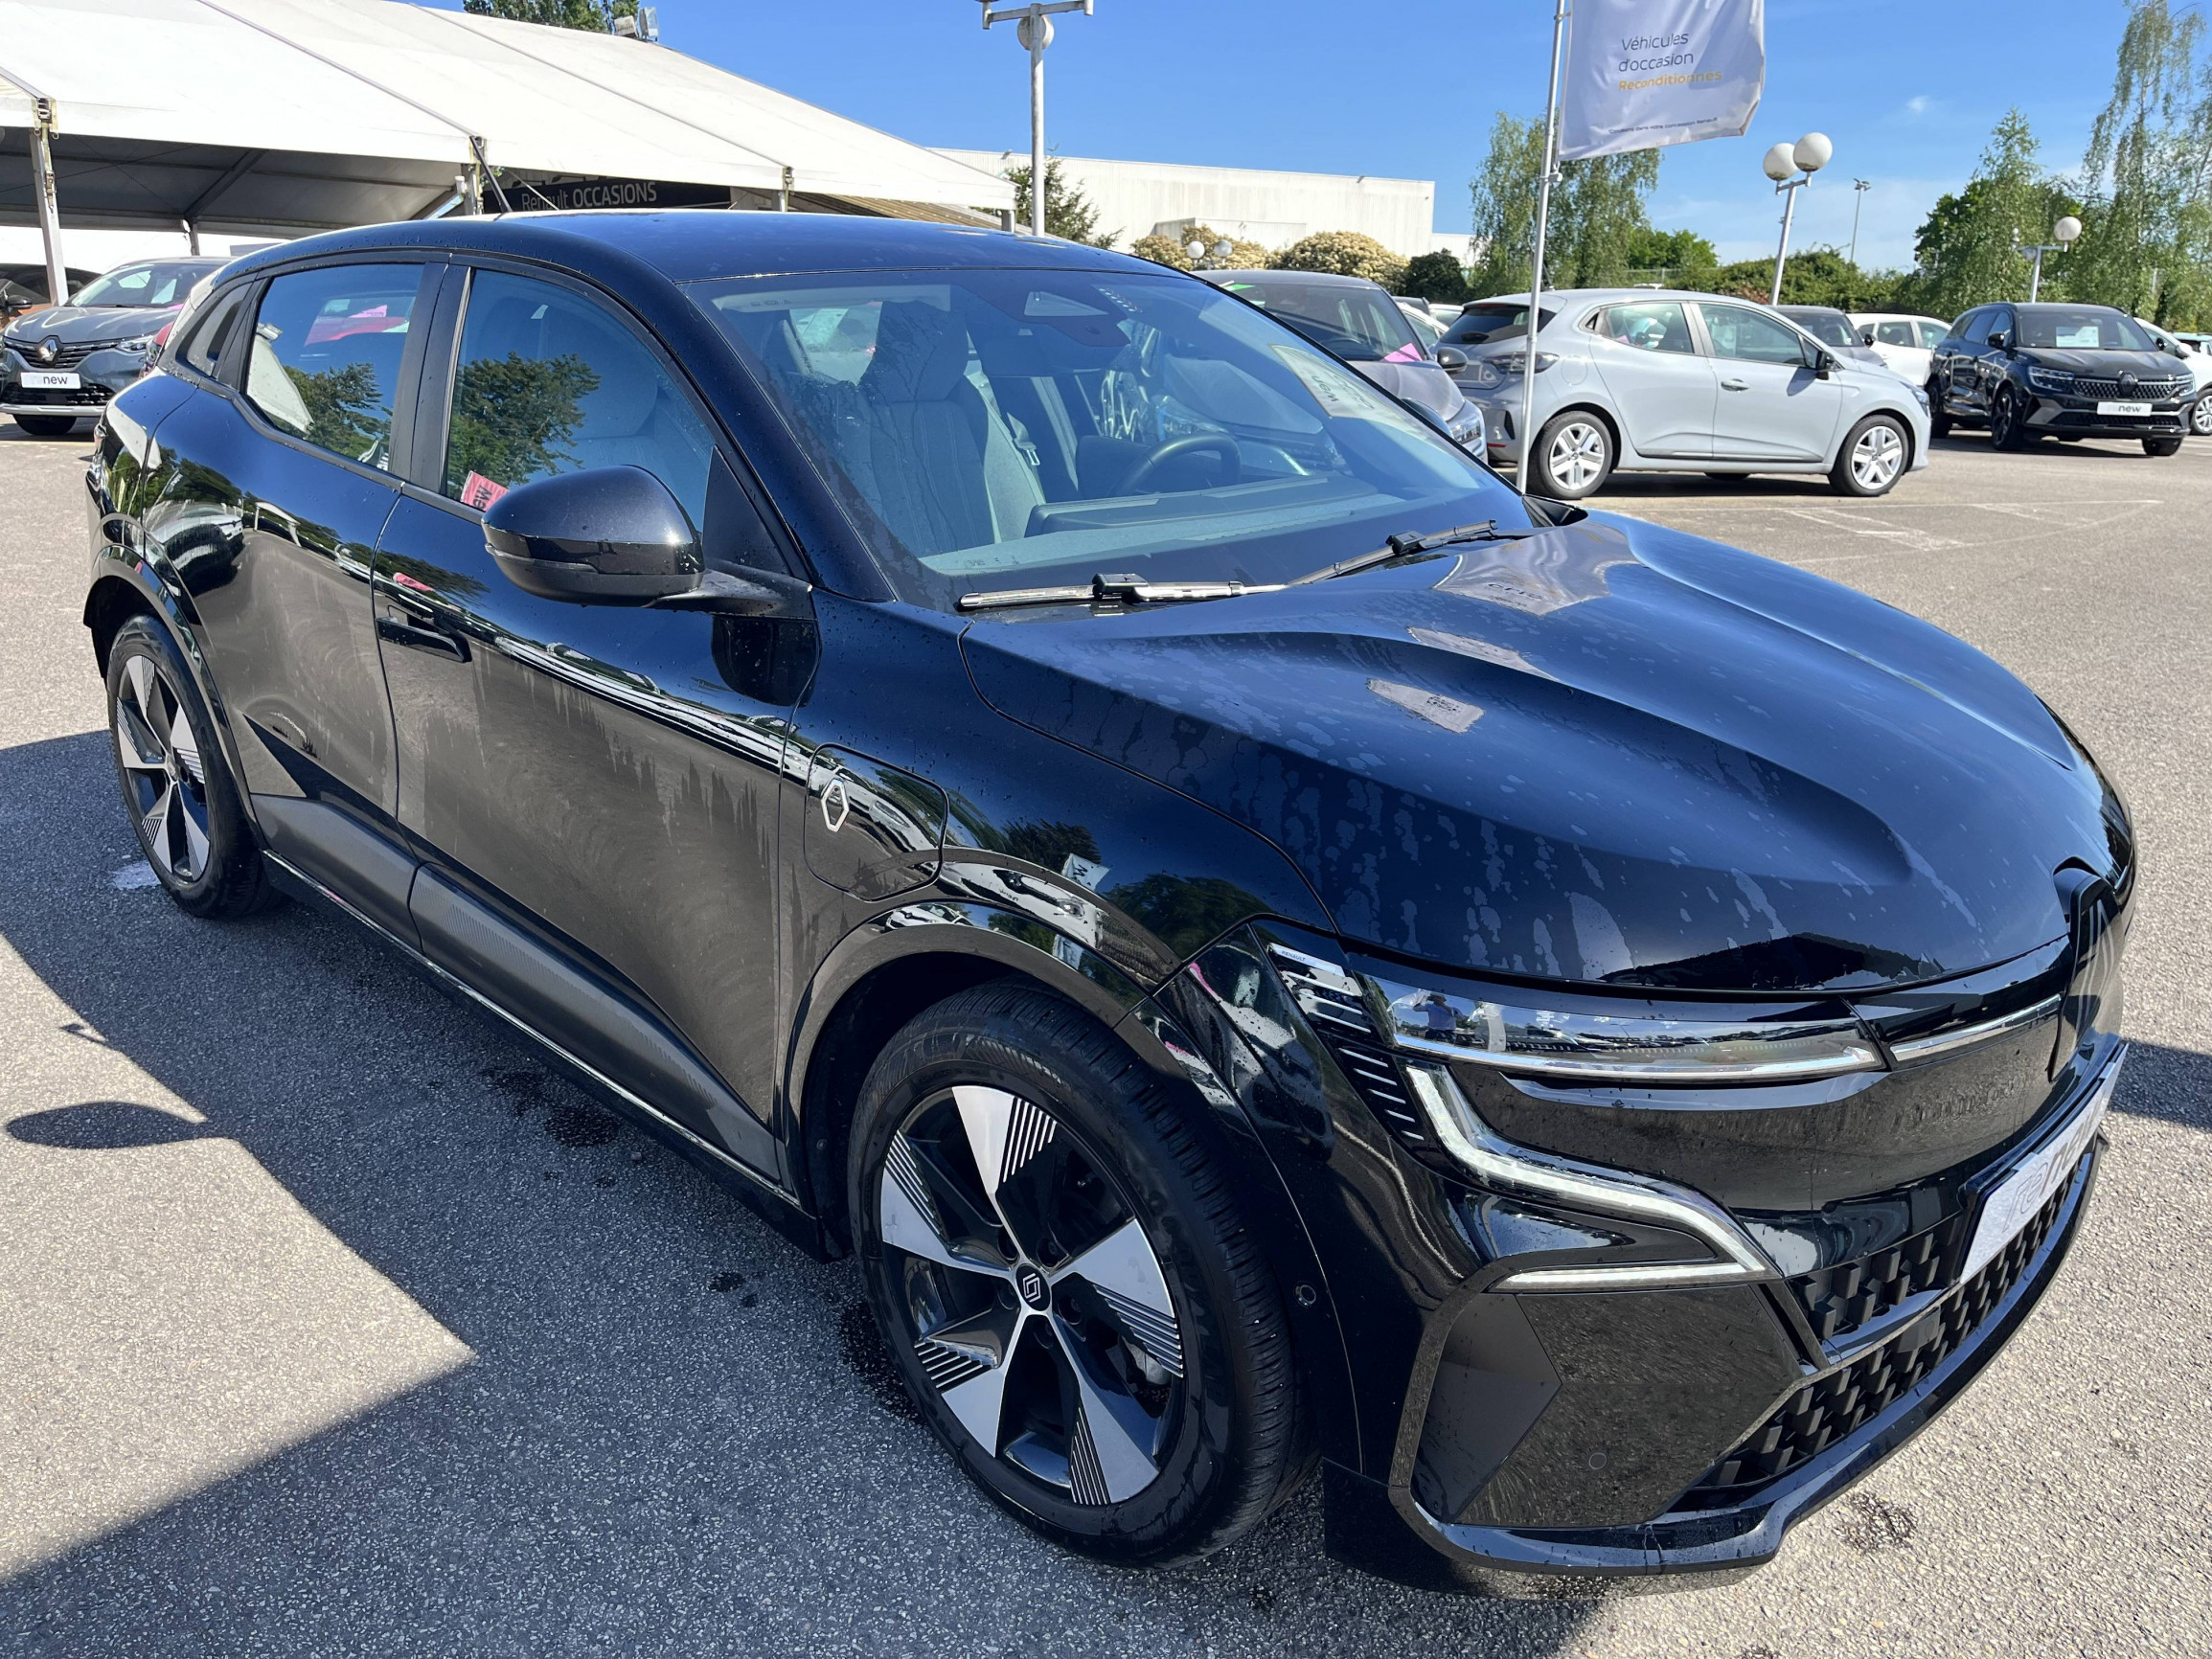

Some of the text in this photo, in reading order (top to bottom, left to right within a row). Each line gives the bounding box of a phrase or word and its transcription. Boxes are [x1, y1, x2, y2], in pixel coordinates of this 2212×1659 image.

[1621, 34, 1689, 51] Véhicules
[1618, 53, 1694, 72] d'occasion
[1618, 69, 1723, 91] Reconditionnés
[521, 182, 657, 211] Renault OCCASIONS
[472, 485, 493, 510] ew
[1281, 950, 1306, 962] RENAULT
